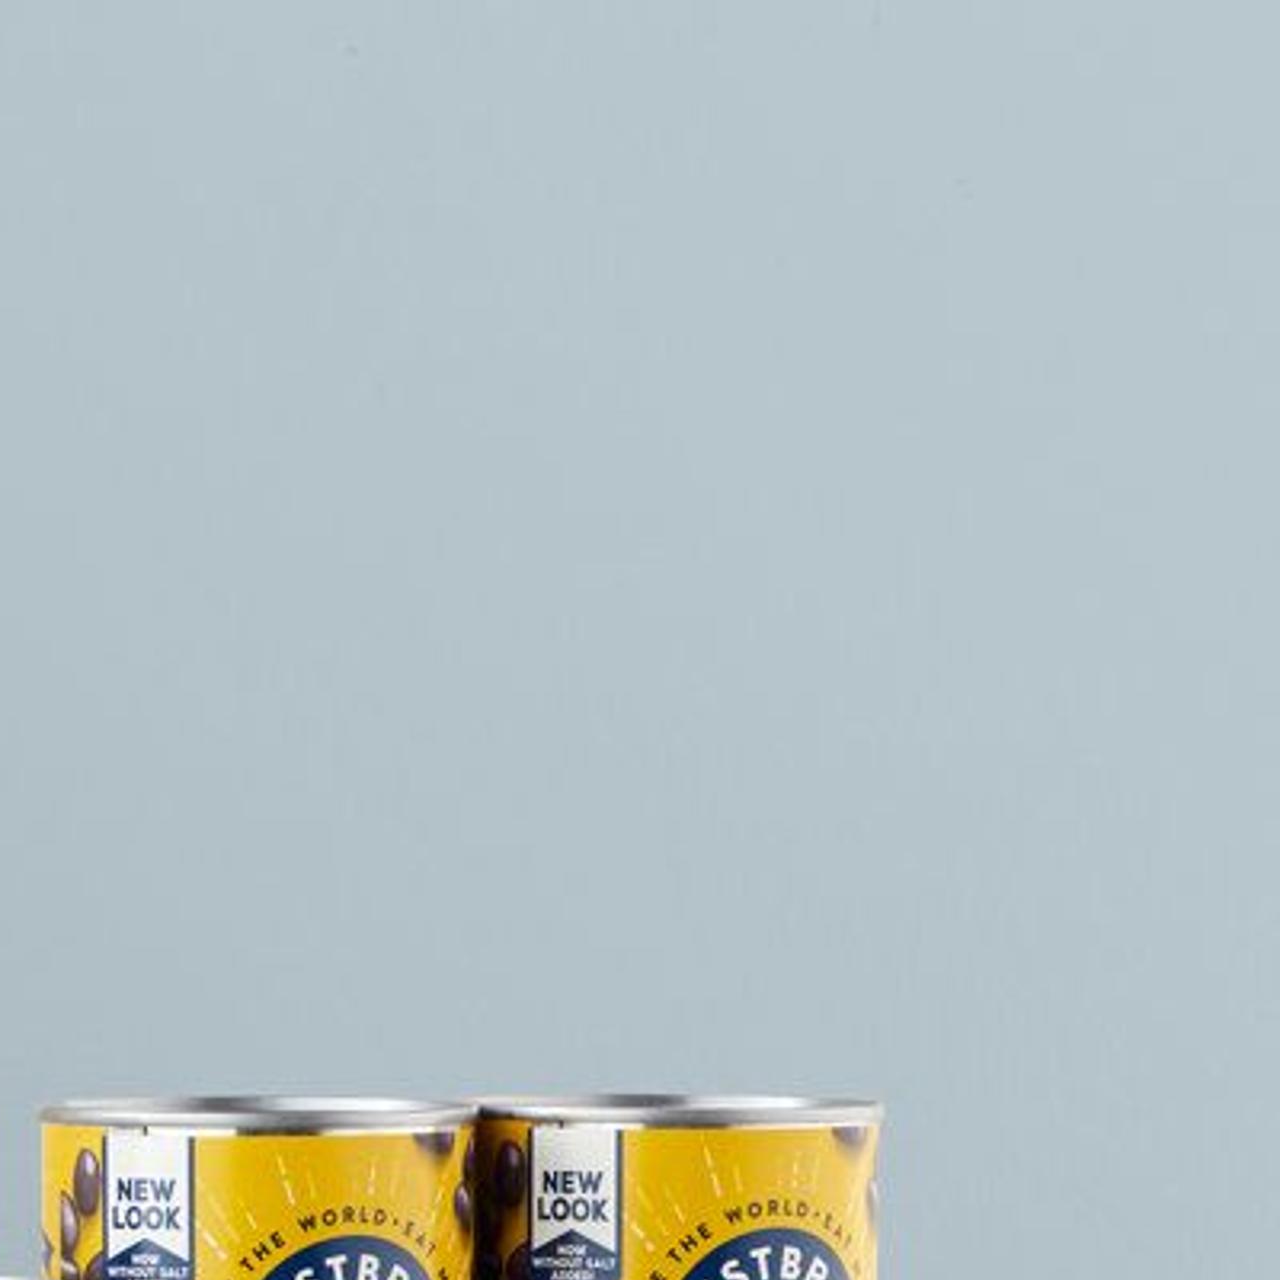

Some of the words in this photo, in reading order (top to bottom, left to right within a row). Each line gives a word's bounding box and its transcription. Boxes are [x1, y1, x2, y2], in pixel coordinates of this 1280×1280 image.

[117, 1177, 176, 1202] NEW
[542, 1170, 602, 1196] NEW
[112, 1205, 180, 1231] LOOK
[537, 1196, 609, 1223] LOOK
[240, 1231, 286, 1272] THE
[296, 1204, 388, 1235] WORLD
[666, 1223, 715, 1264] THE
[724, 1199, 813, 1227] WORLD
